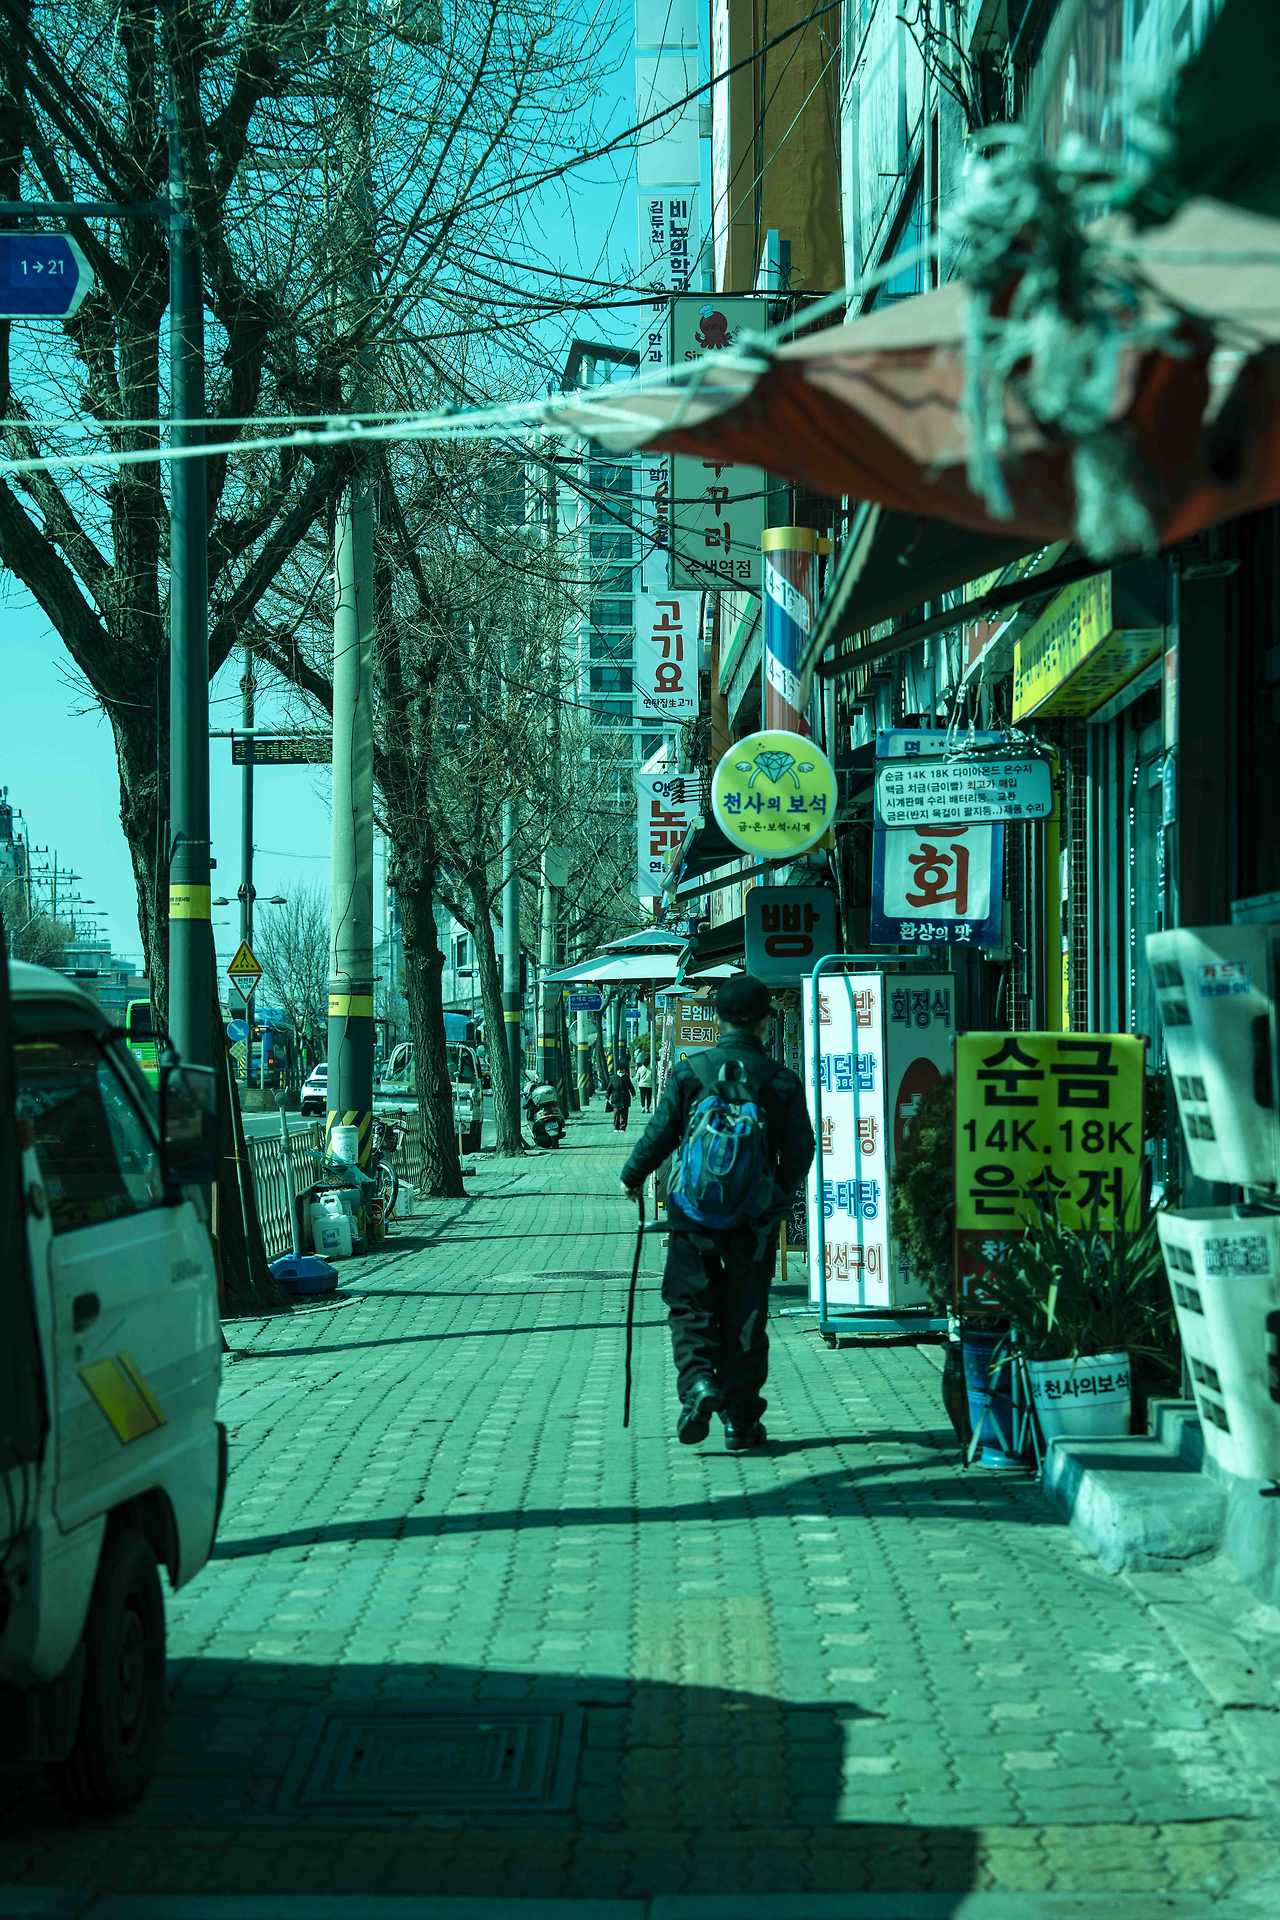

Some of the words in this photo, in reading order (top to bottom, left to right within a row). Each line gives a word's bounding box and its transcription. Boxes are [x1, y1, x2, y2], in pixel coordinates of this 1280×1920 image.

[20, 260, 27, 275] 1
[48, 260, 64, 275] 21
[651, 601, 684, 693] 고기요
[908, 770, 926, 779] 14K
[930, 769, 949, 778] 18K
[723, 792, 780, 815] 천사의
[786, 793, 827, 815] 보석
[927, 795, 946, 805] 수리
[905, 826, 970, 915] 회
[762, 902, 820, 957] 빵
[900, 922, 948, 940] 환상의
[954, 923, 973, 941] 맛
[891, 989, 951, 1029] 회정식
[976, 1037, 1119, 1109] 순금
[969, 1164, 1124, 1218] 은수저
